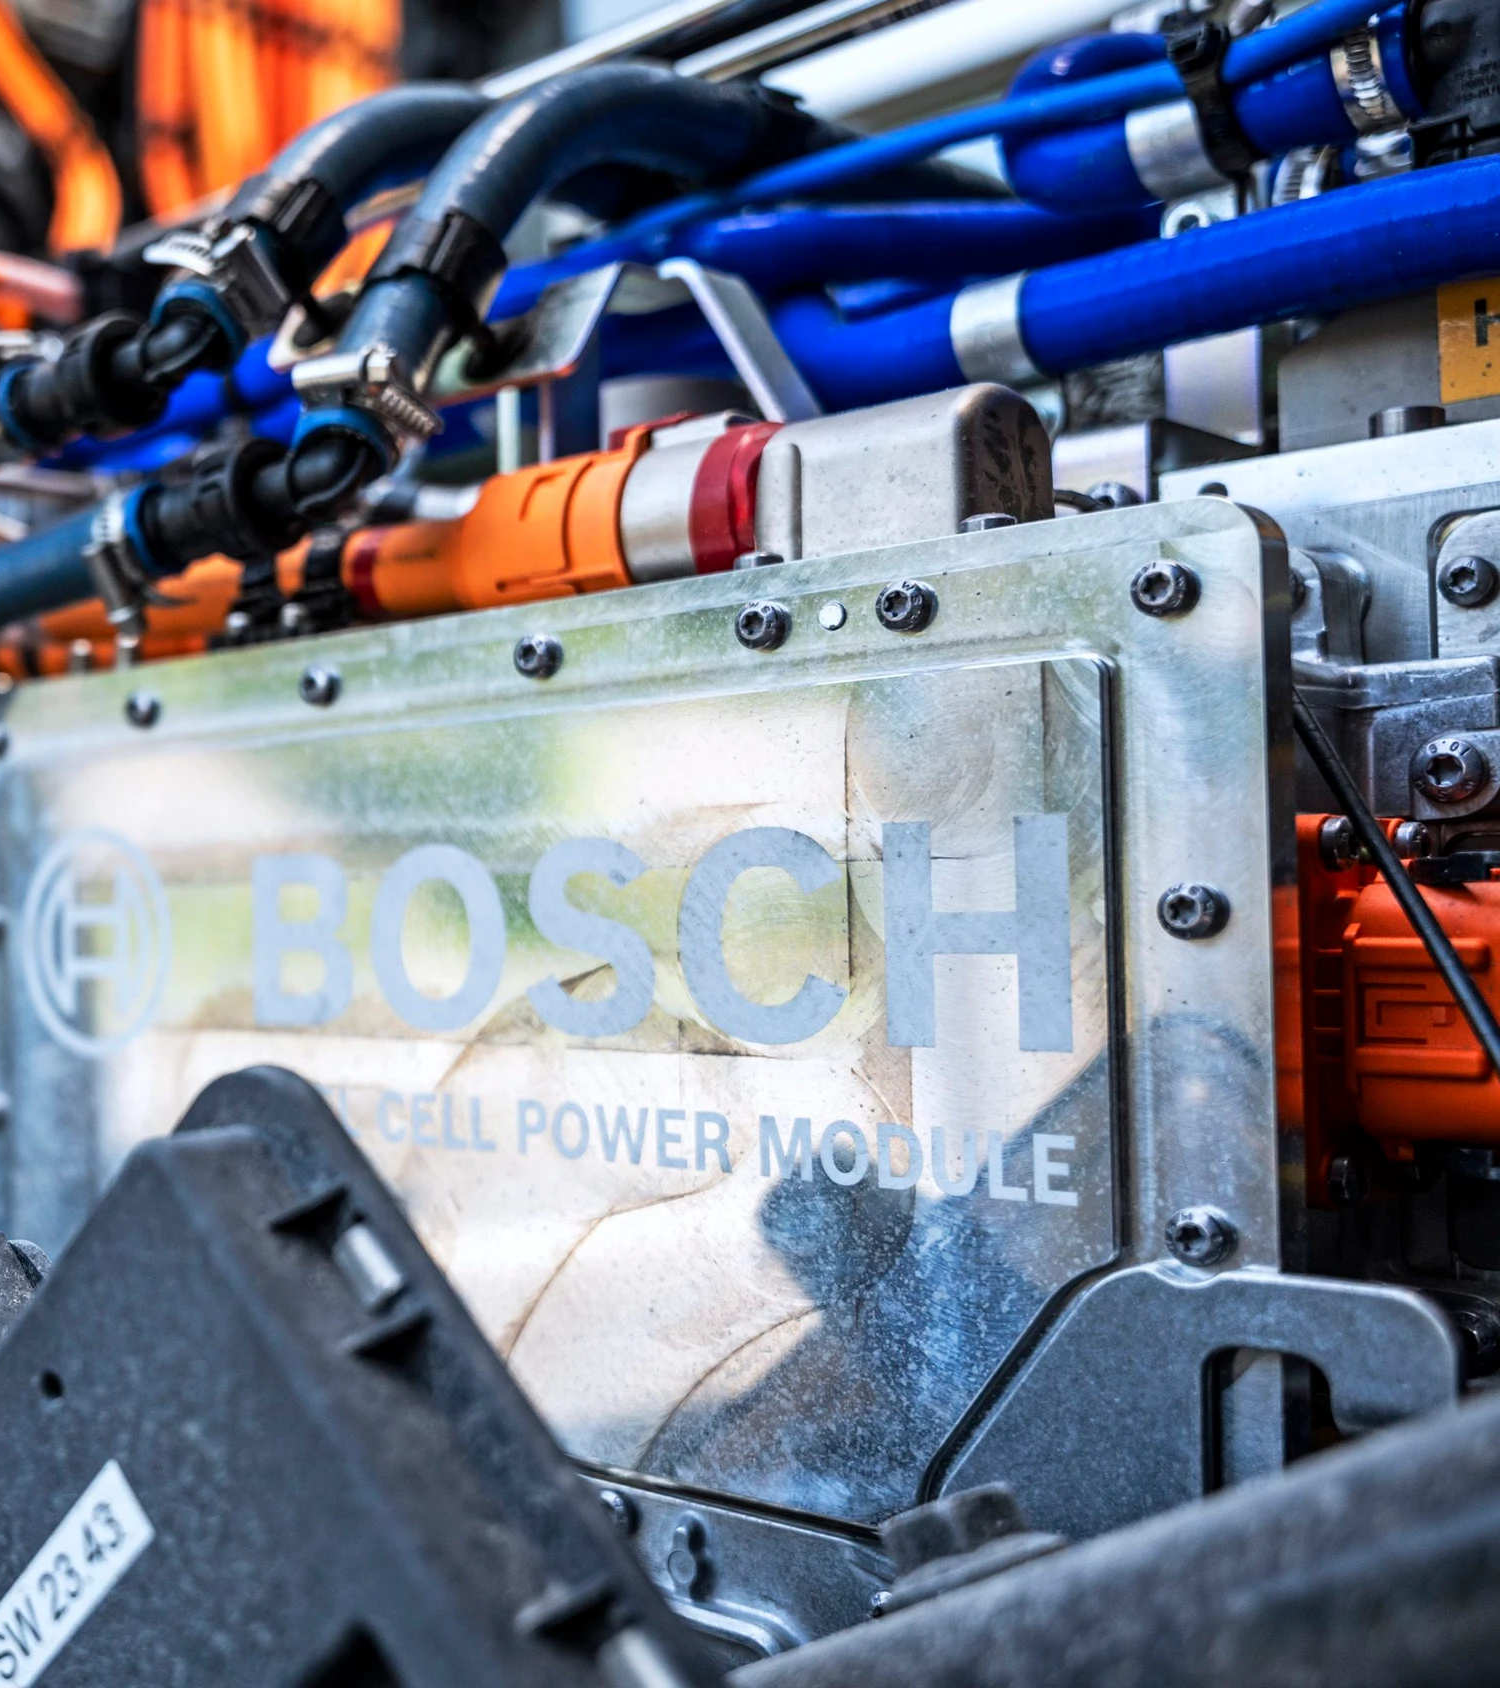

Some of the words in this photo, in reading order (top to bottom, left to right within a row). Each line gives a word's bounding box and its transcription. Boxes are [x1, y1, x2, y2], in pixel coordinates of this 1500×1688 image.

[251, 812, 1074, 1052] BOSCH
[377, 1089, 496, 1152] CELL
[517, 1099, 733, 1173] POWER
[759, 1115, 1078, 1207] MODULE
